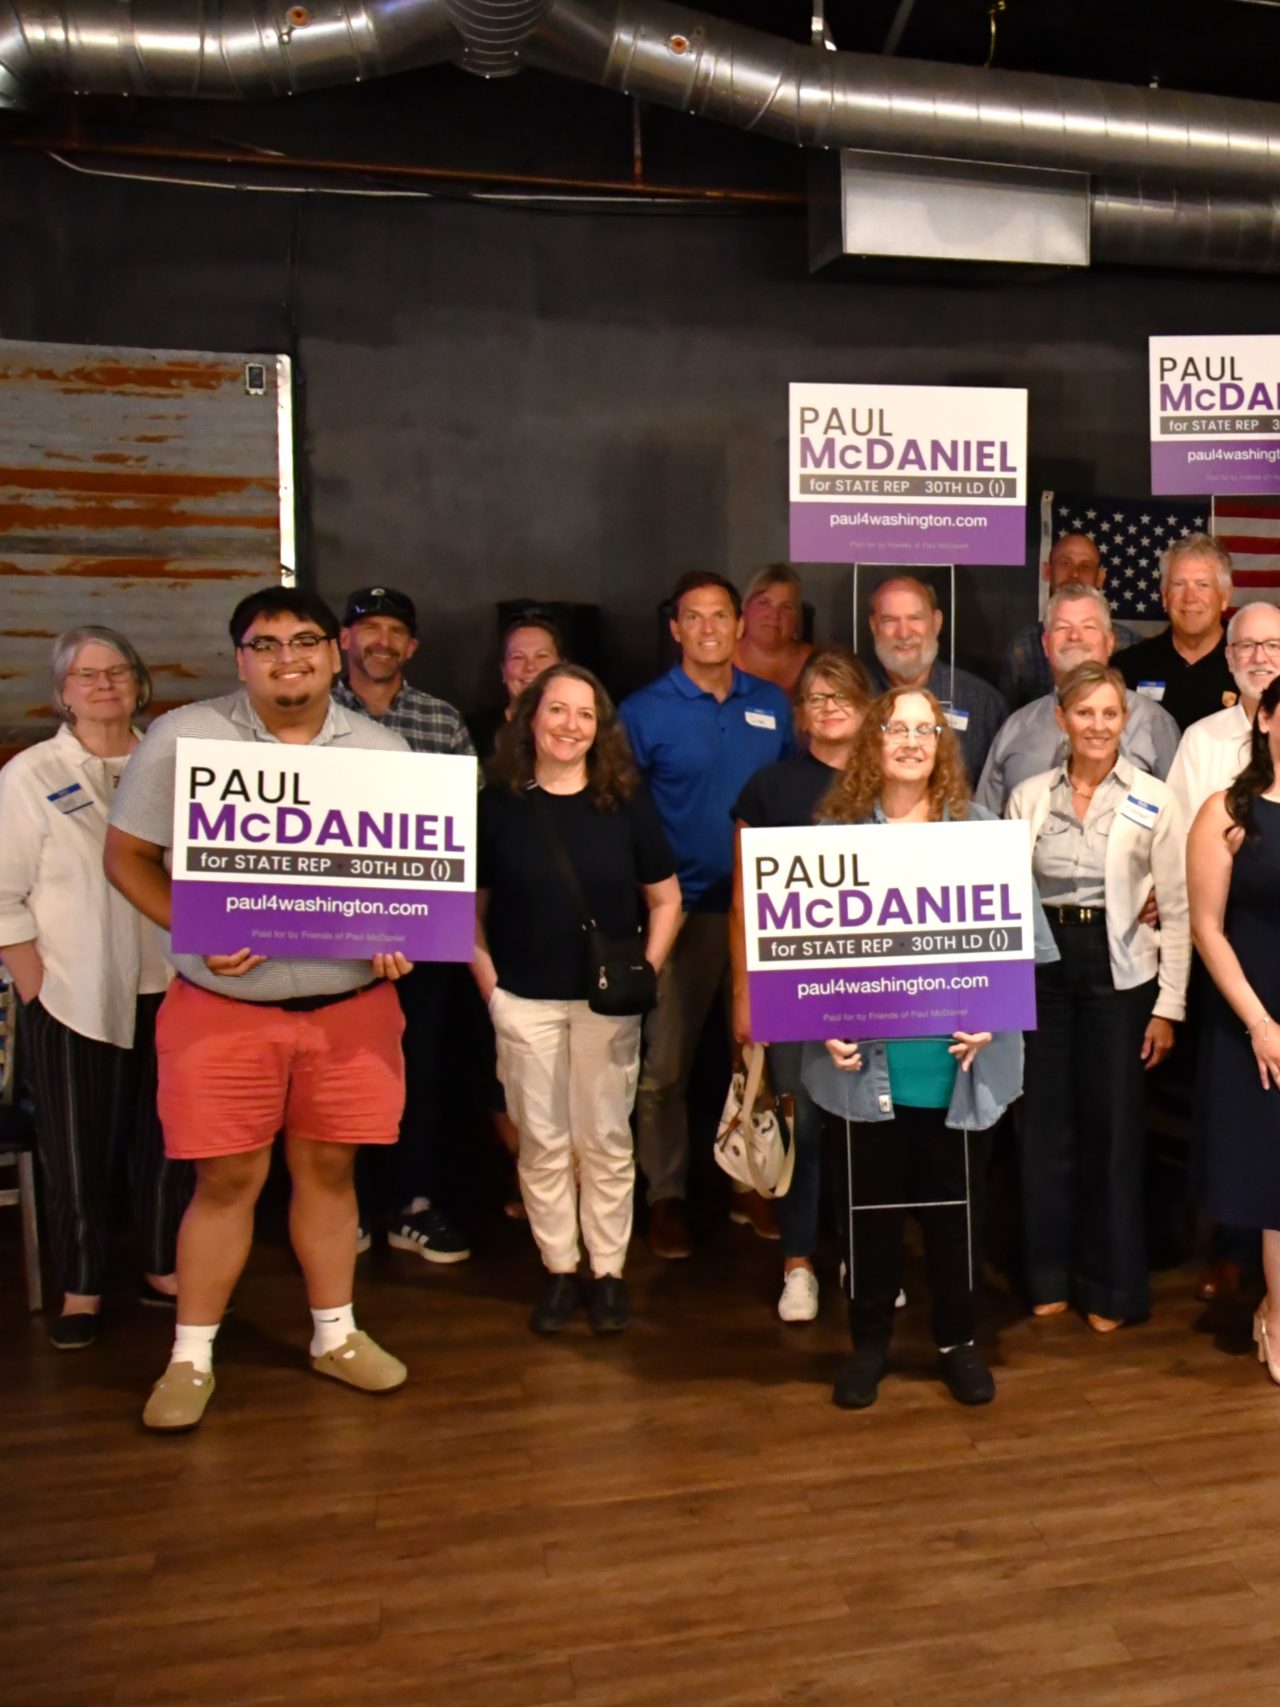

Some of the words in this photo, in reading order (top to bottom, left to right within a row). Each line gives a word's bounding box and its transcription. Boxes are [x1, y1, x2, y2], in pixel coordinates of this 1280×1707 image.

[1160, 356, 1243, 382] PAUL
[800, 406, 893, 436] PAUL
[1169, 420, 1188, 431] for
[1192, 419, 1231, 431] STATE
[1236, 420, 1259, 431] REP
[800, 437, 1017, 472] McDANIEL
[810, 478, 830, 492] for
[835, 479, 878, 492] STATE
[884, 480, 910, 493] REP
[925, 481, 962, 494] 30TH
[967, 481, 983, 494] LD
[830, 512, 987, 529] paul4washington.com
[189, 766, 310, 806] PAUL
[187, 802, 466, 853] McDANIEL
[200, 852, 229, 870] for
[235, 854, 292, 872] STATE
[297, 856, 331, 873] REP
[350, 858, 397, 876] 30TH
[403, 860, 424, 877] LD
[755, 853, 870, 890] PAUL
[226, 894, 429, 917] paul4washington.com
[756, 883, 1022, 931] McDANIEL
[771, 941, 797, 957] for
[802, 940, 855, 957] STATE
[861, 938, 893, 954] REP
[911, 936, 956, 952] 30TH
[962, 934, 983, 950] LD
[797, 973, 989, 999] paul4washington.com
